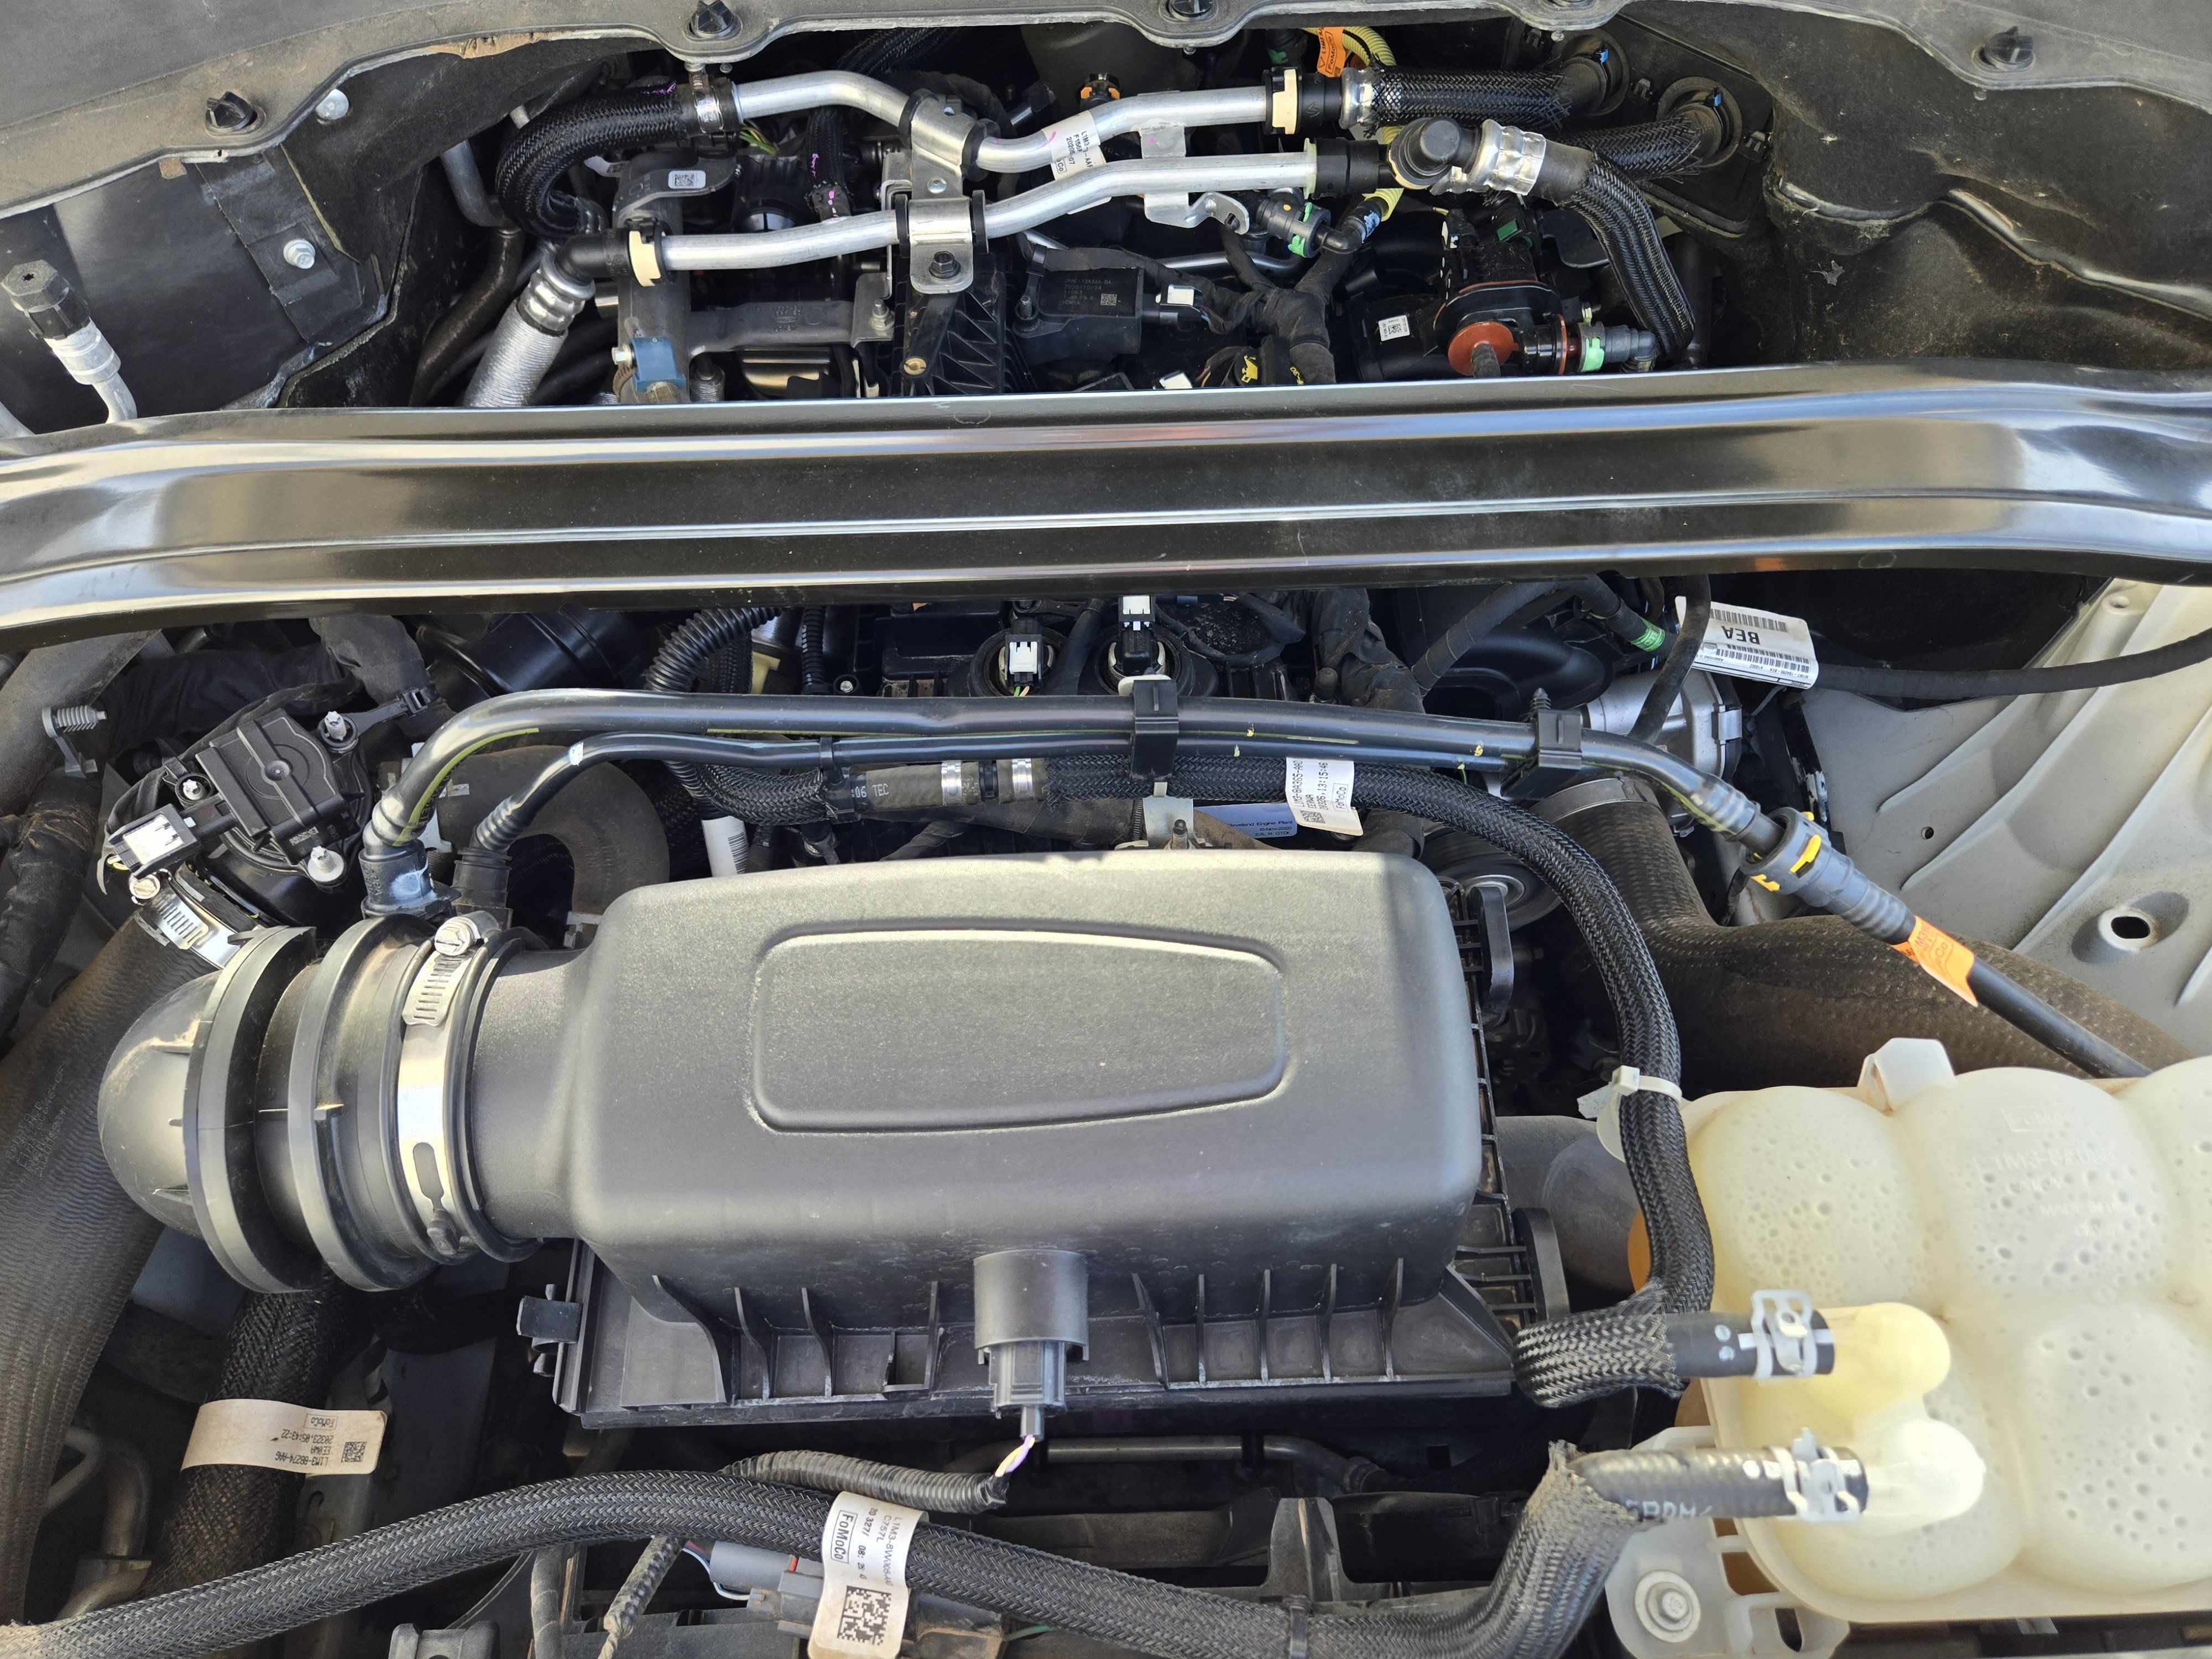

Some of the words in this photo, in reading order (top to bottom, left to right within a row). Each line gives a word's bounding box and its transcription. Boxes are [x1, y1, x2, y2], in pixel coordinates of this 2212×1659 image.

[1721, 625, 1761, 645] BEA
[872, 783, 889, 797] TEC
[1335, 787, 1347, 810] FoMoCo
[311, 1417, 335, 1428] FoMoCo
[834, 1514, 854, 1560] FoMoCo
[876, 1515, 892, 1543] C757L
